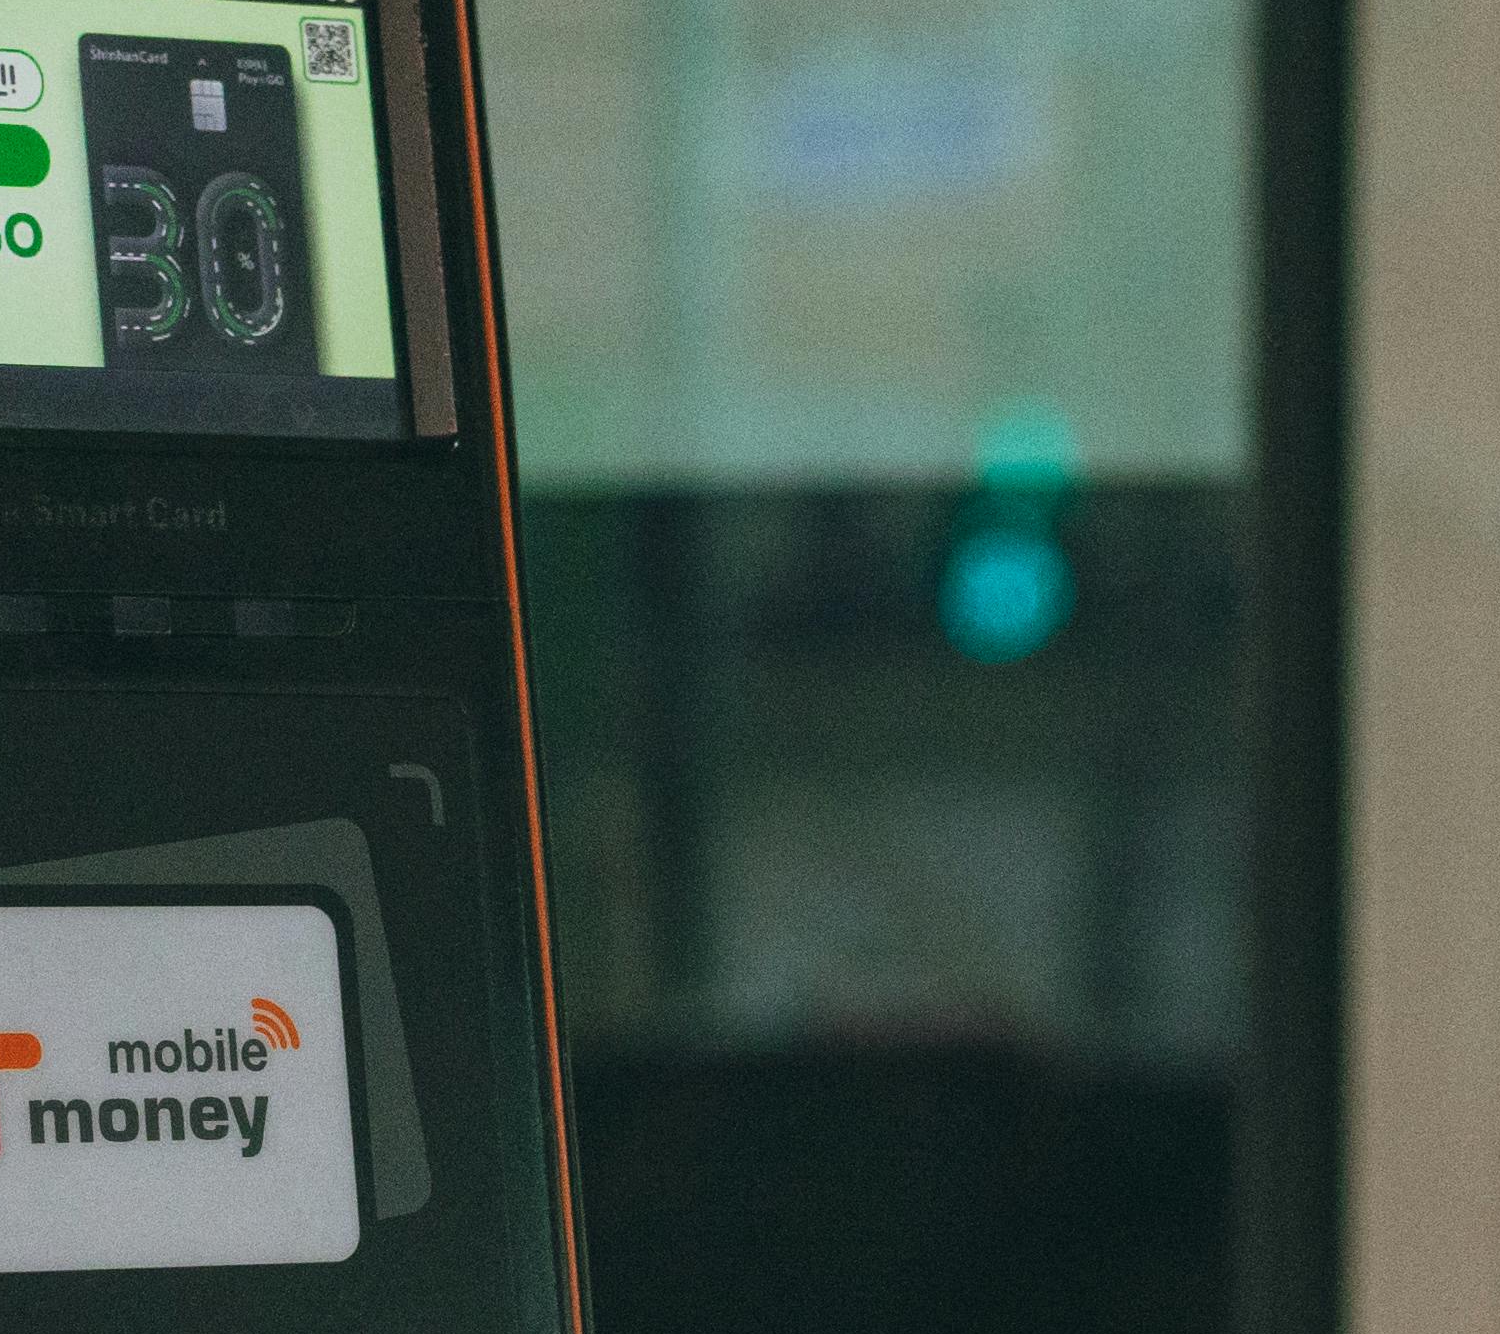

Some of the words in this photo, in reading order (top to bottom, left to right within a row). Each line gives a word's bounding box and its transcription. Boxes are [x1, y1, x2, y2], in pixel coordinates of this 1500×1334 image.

[31, 493, 136, 529] Smart
[144, 495, 230, 533] Card
[108, 1028, 269, 1073] mobile
